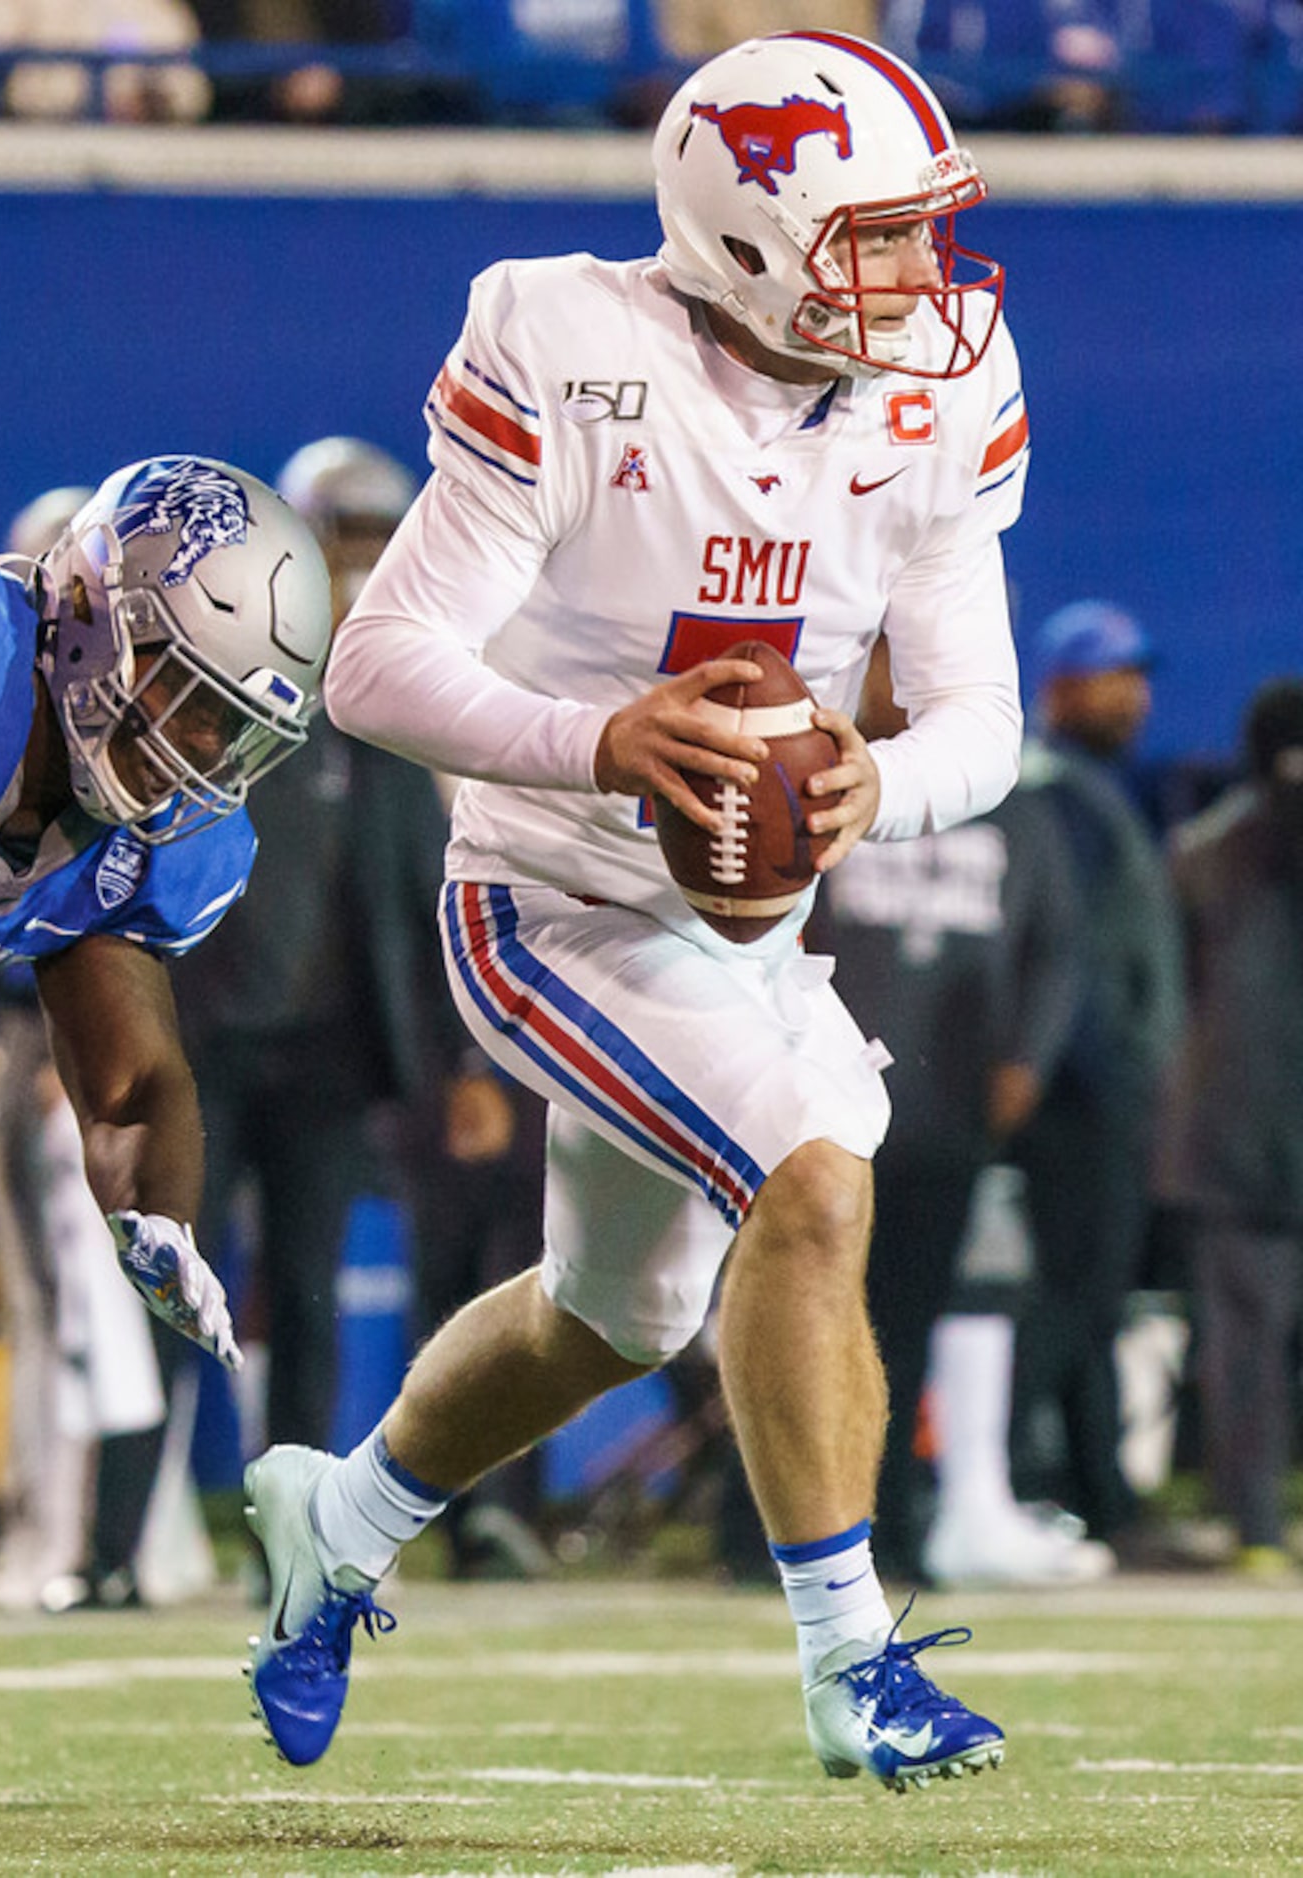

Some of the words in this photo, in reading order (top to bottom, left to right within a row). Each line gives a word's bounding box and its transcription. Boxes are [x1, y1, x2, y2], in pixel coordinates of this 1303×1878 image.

[560, 381, 648, 424] 150
[888, 393, 932, 441] C
[609, 442, 652, 493] A
[698, 534, 811, 607] SMU
